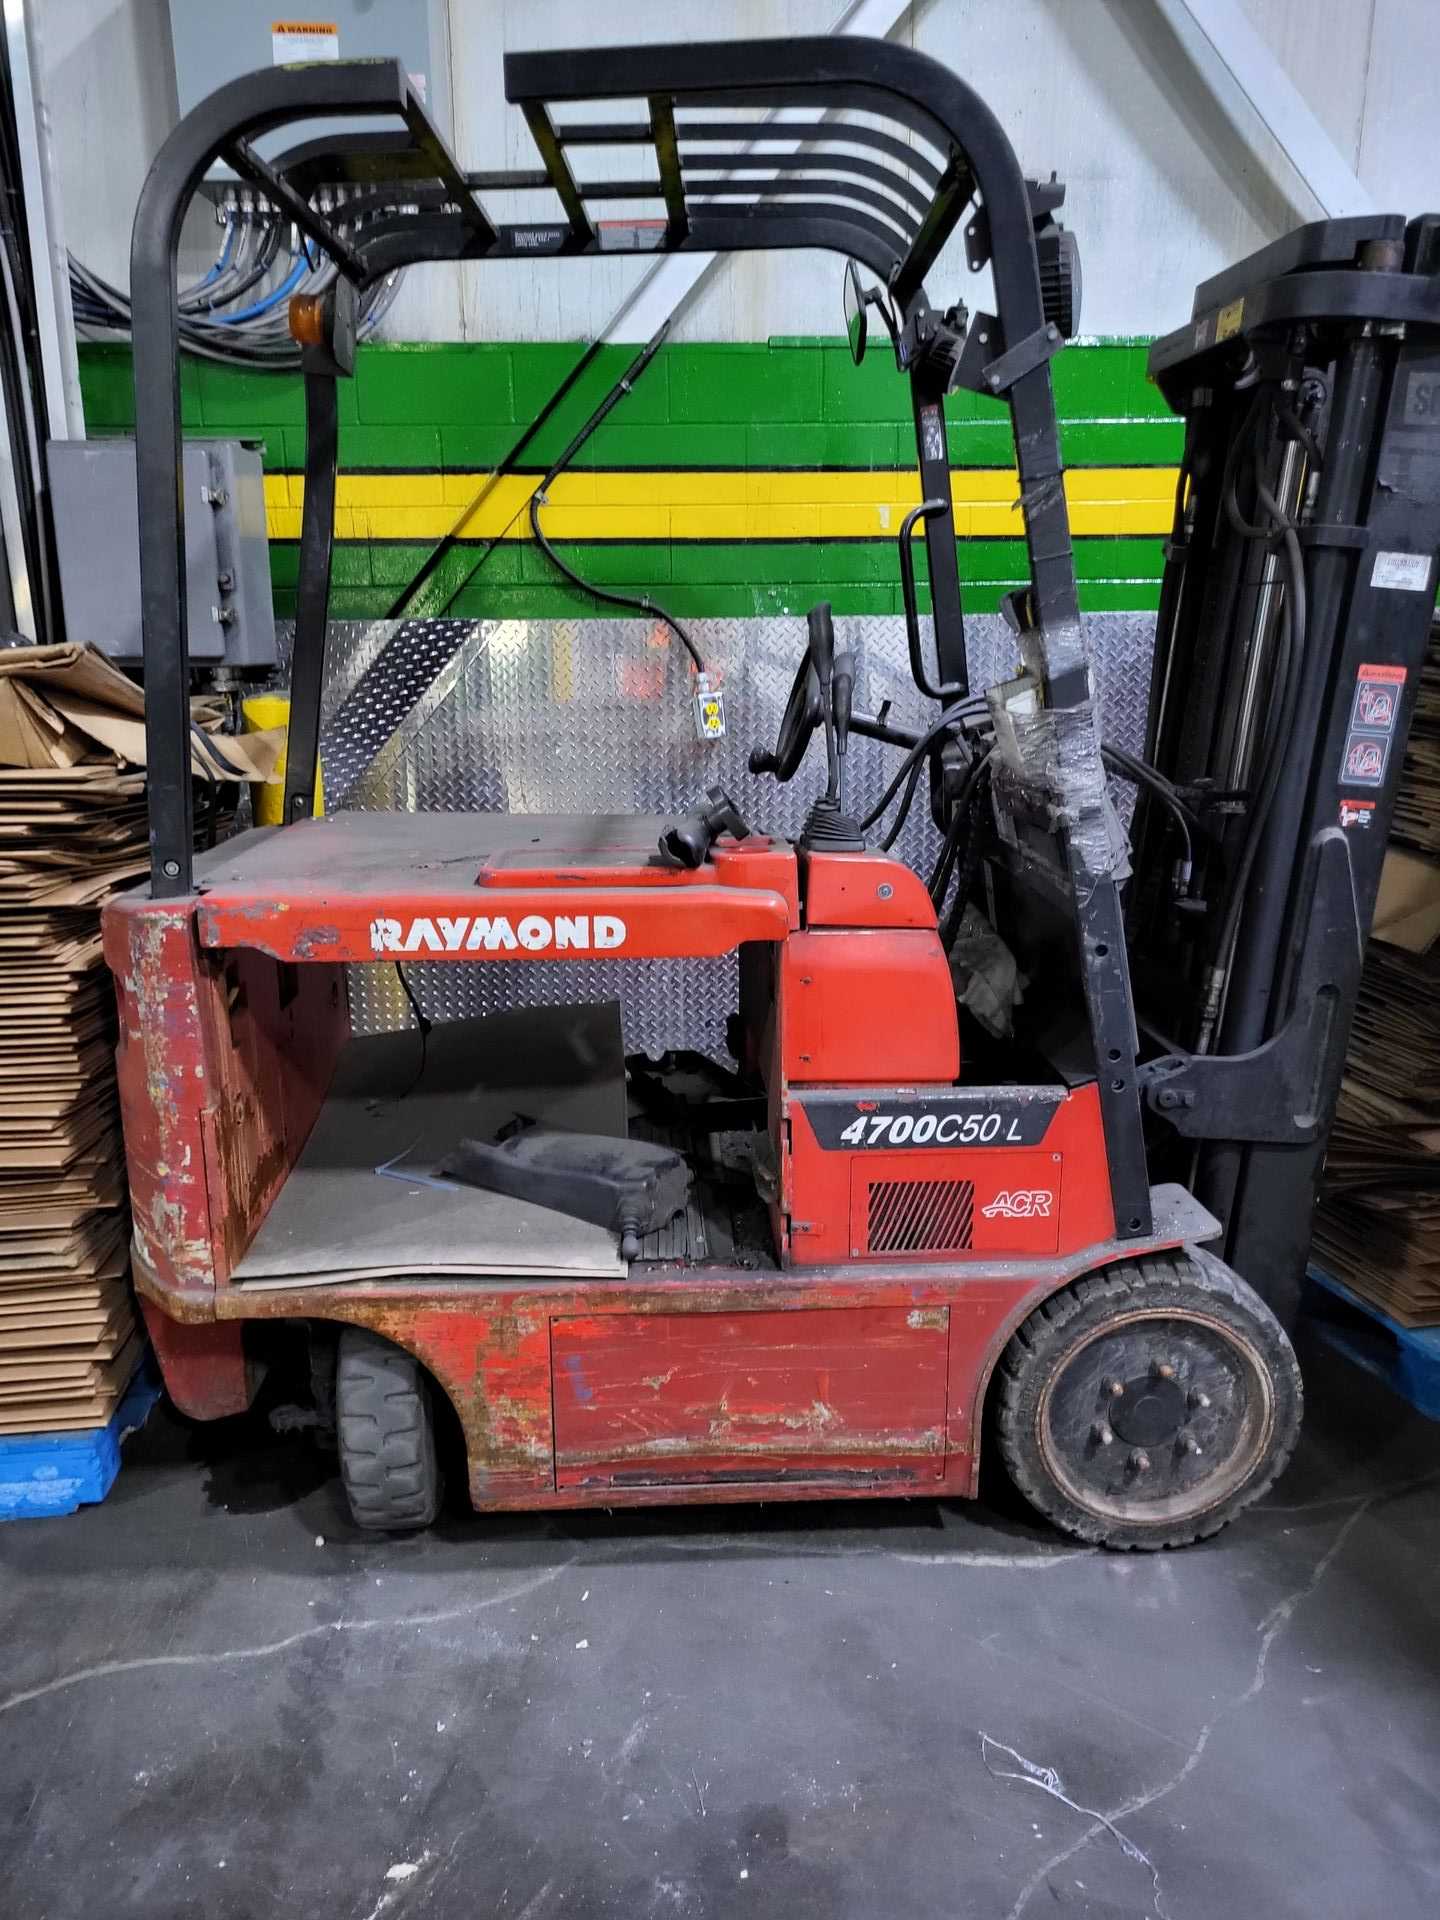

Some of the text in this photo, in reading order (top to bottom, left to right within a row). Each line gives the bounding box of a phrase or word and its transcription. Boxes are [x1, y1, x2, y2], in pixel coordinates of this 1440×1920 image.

[288, 24, 333, 34] WARNING
[370, 915, 627, 951] RAYMOND
[841, 1114, 1001, 1144] 4700C50
[982, 1191, 1053, 1218] ACR
